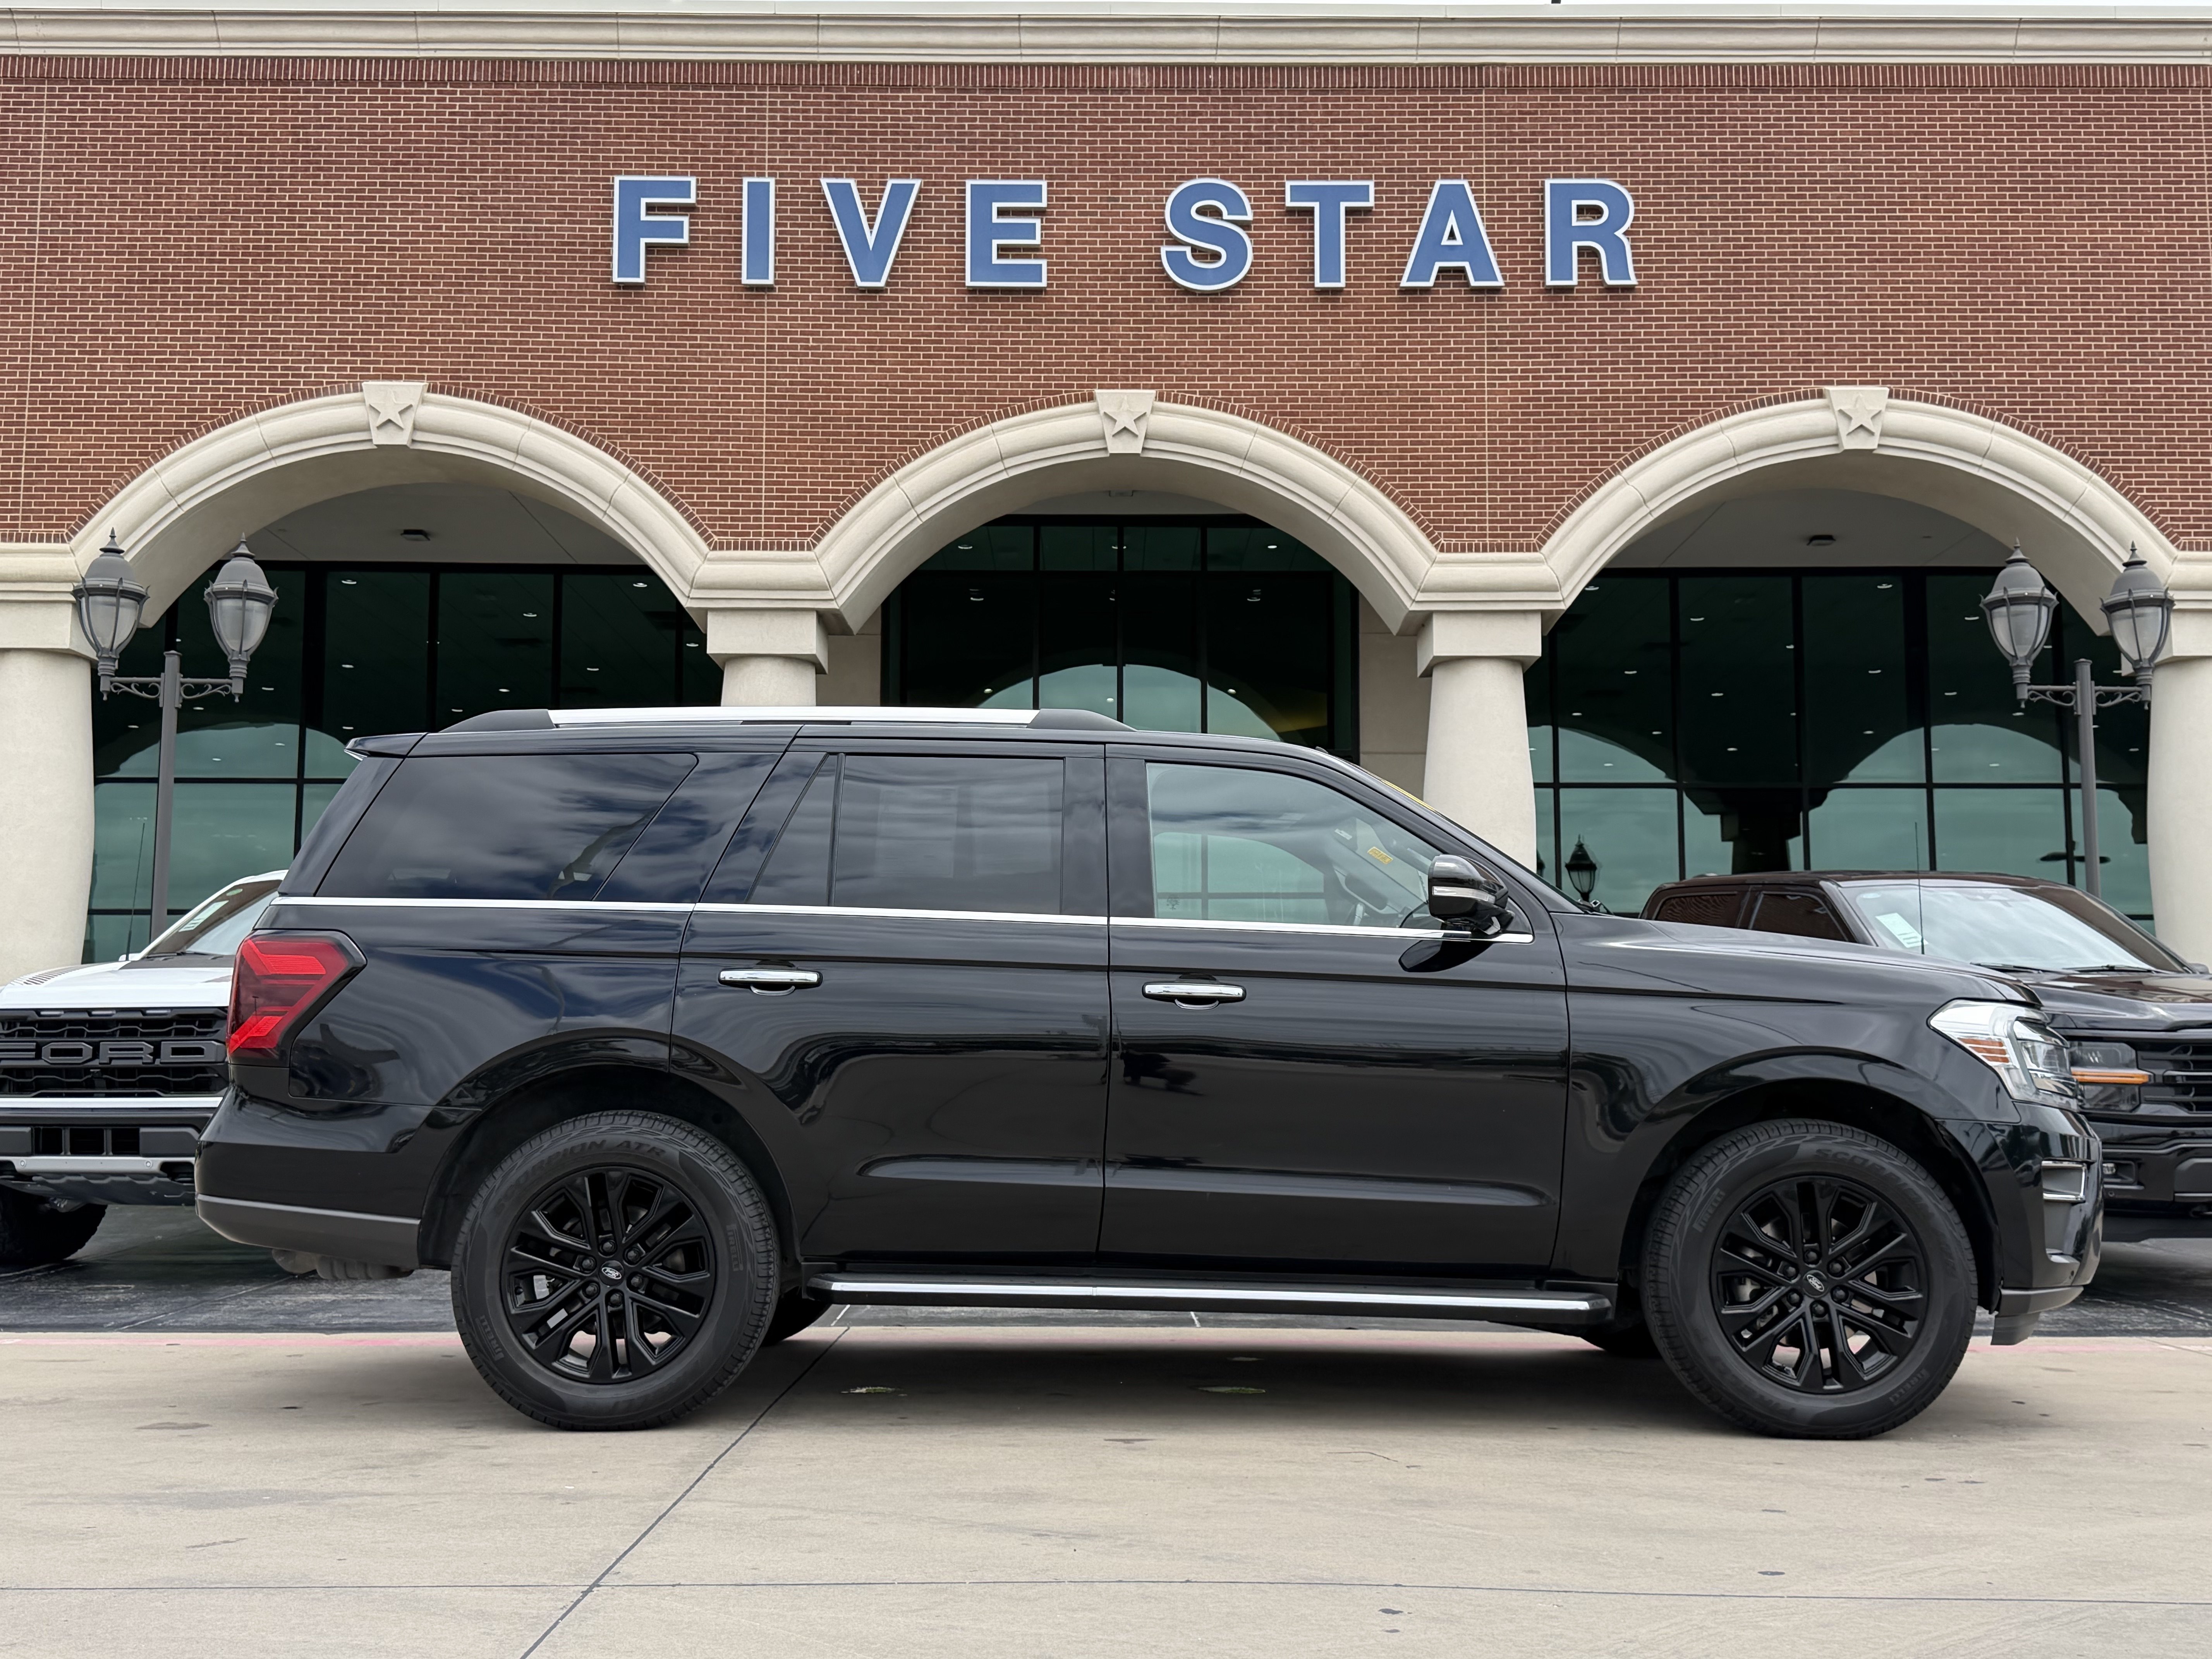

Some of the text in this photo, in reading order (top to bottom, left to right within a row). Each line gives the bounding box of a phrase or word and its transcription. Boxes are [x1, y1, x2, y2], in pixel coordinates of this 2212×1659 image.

[613, 176, 1638, 291] FIVE STAR
[614, 1140, 665, 1157] ATR
